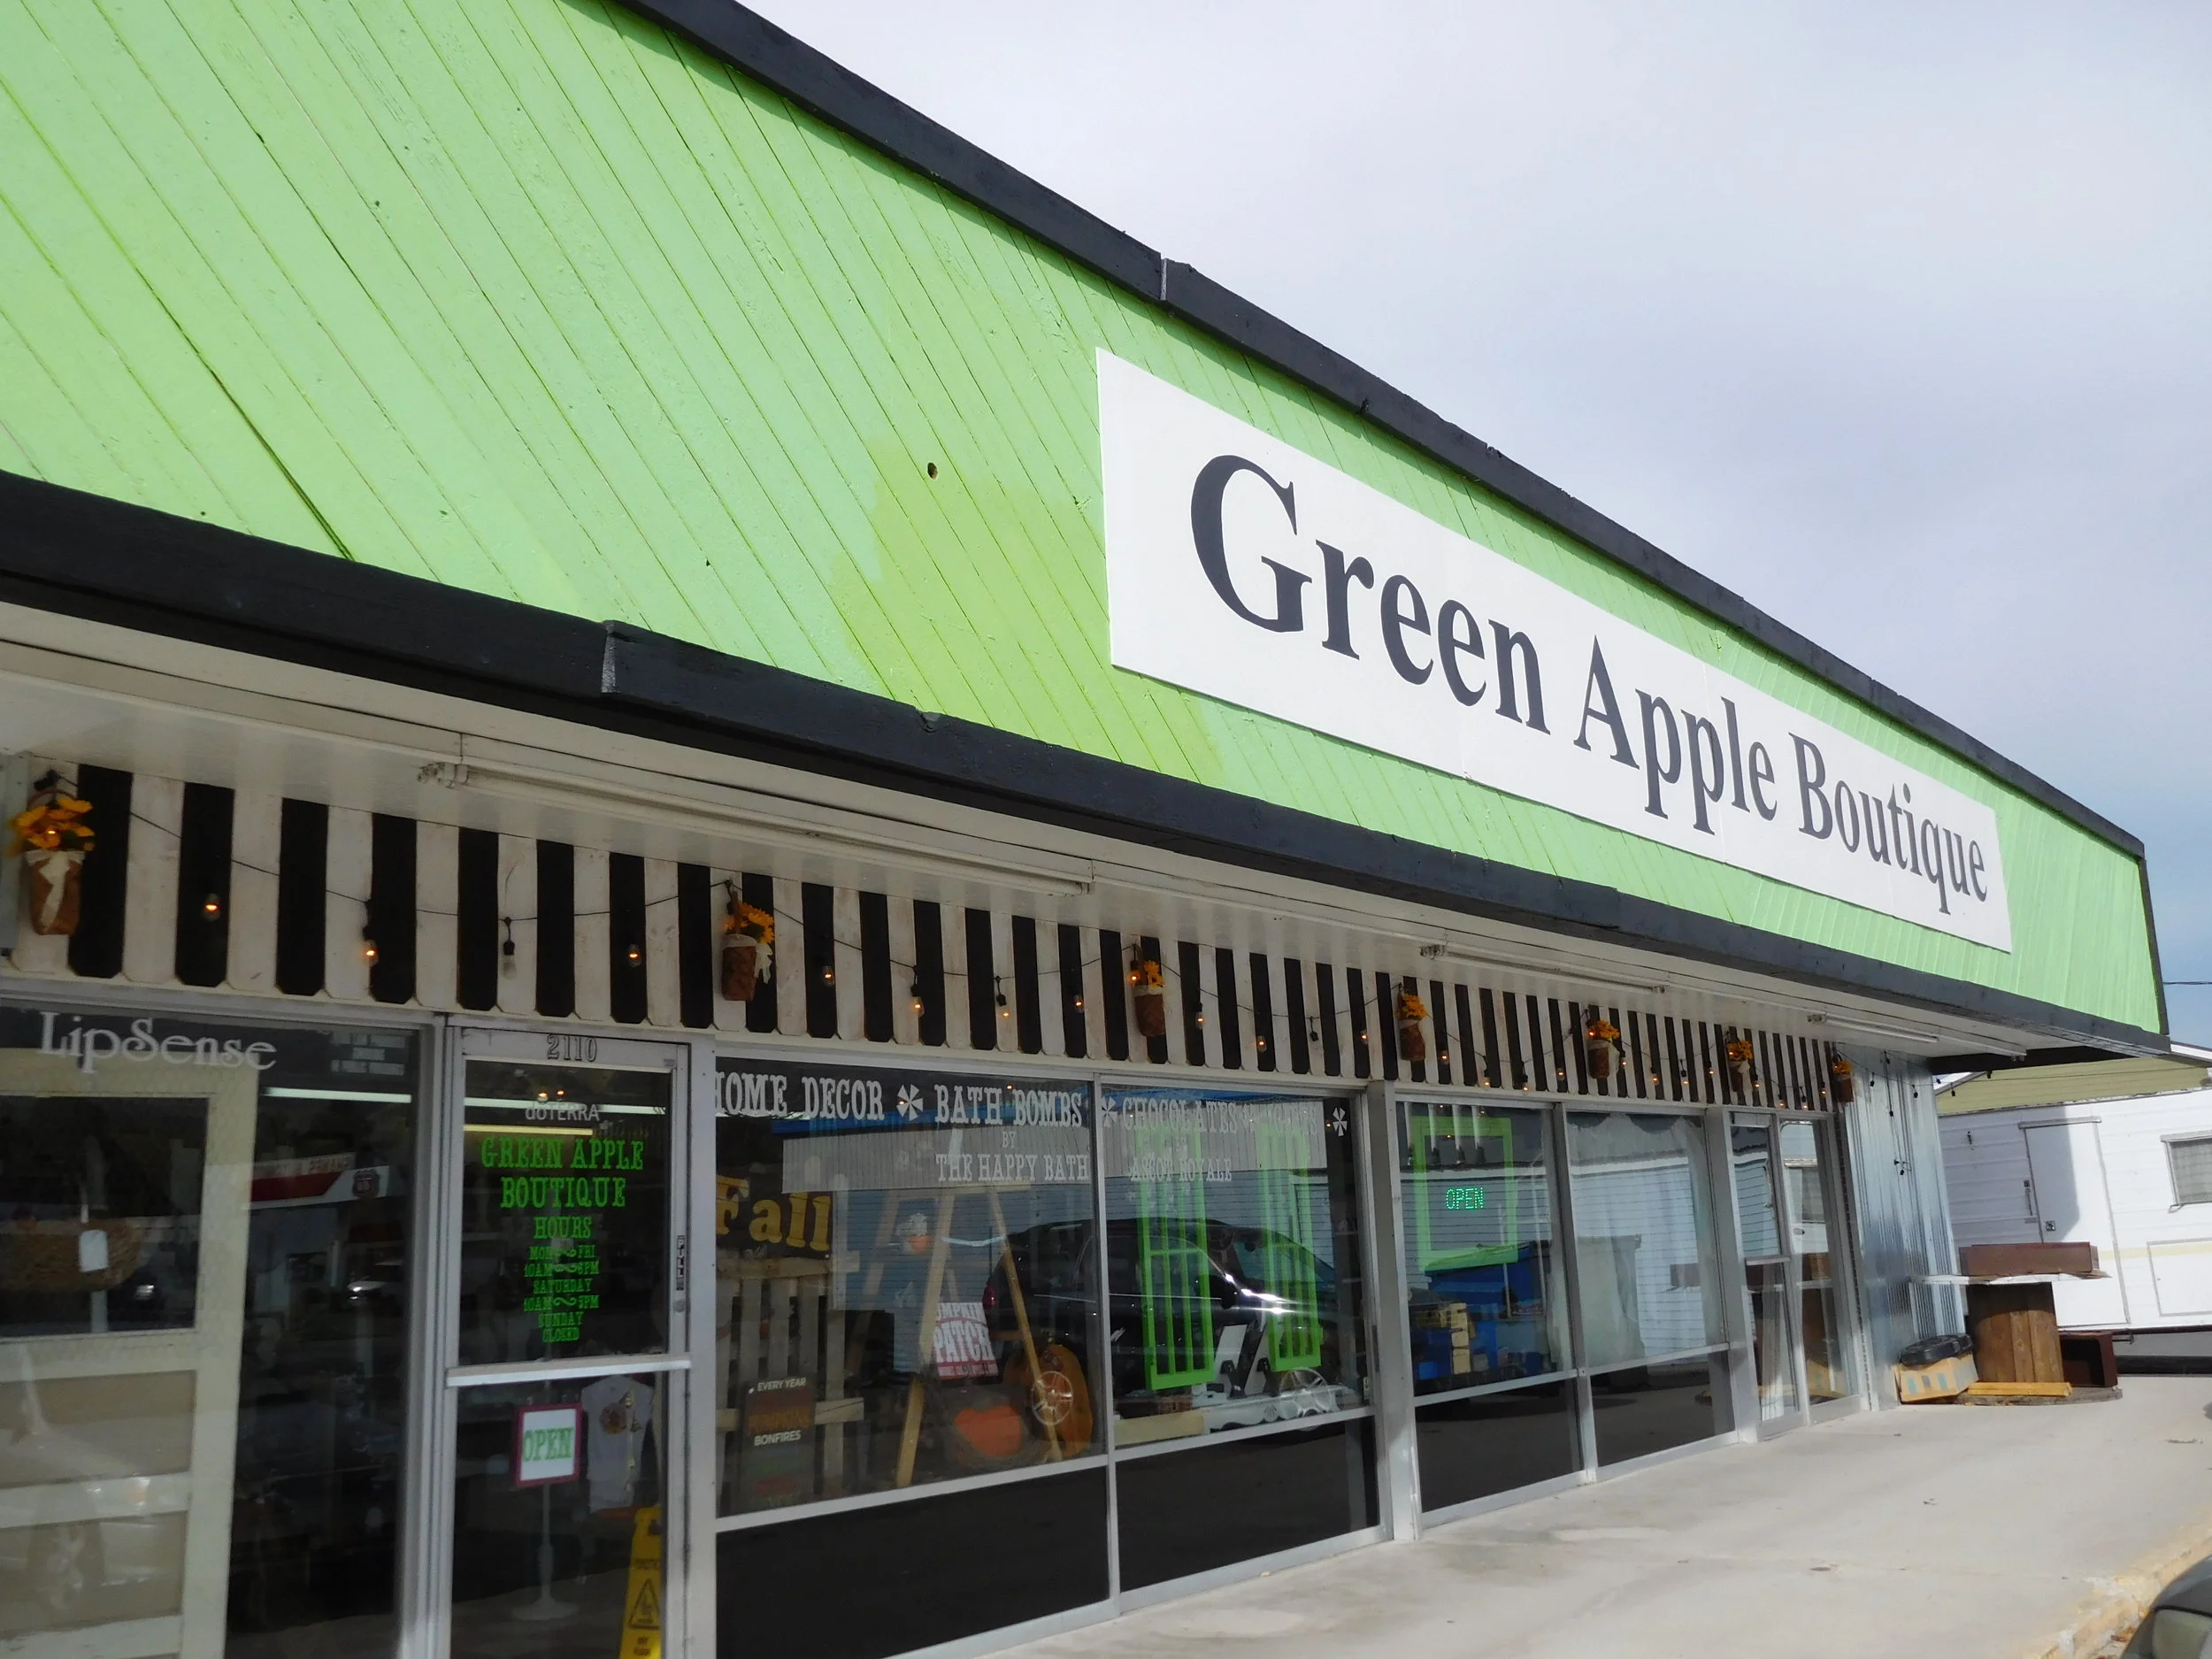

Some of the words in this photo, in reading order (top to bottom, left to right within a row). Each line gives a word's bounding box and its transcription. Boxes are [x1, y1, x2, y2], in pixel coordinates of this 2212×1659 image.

[1190, 454, 1551, 735] Green
[1573, 634, 1778, 836] Apple
[1788, 732, 1988, 916] Boutique
[36, 1011, 277, 1074] LipSense
[546, 1033, 598, 1063] 2110
[802, 1076, 885, 1120] DECOR
[934, 1084, 1002, 1125] BATH
[1012, 1088, 1082, 1128] BOMBS
[480, 1137, 564, 1170] GREEN
[570, 1138, 644, 1171] APPLE
[1002, 1131, 1017, 1148] BY
[936, 1153, 972, 1182] THE
[978, 1153, 1038, 1182] HAPPY
[1043, 1154, 1090, 1182] BATH
[500, 1177, 626, 1209] BOUTIQUE
[1445, 1187, 1486, 1210] OPEN
[716, 1174, 831, 1251] Fall
[534, 1216, 594, 1240] HOURS
[533, 1278, 593, 1294] SATURDAY
[537, 1311, 584, 1329] SUNDAY
[934, 1302, 987, 1325] UMPKIN
[933, 1319, 996, 1363] PATCH
[757, 1380, 784, 1392] EVERY
[785, 1378, 806, 1389] YEAR
[522, 1426, 574, 1463] OPEN
[754, 1430, 802, 1447] BONFIRES
